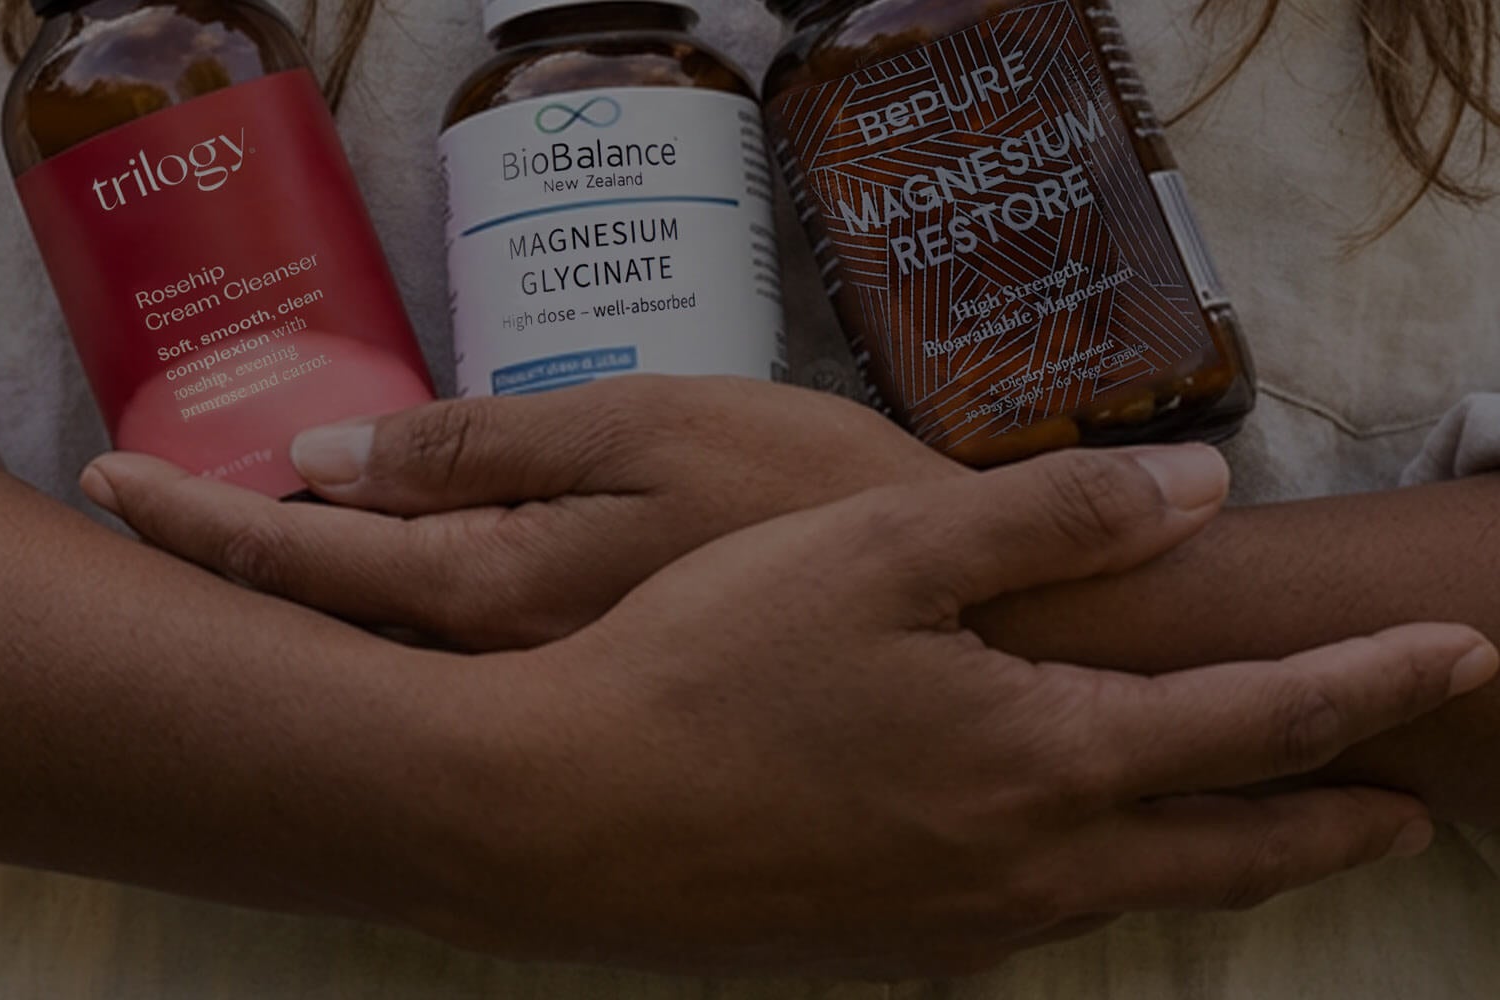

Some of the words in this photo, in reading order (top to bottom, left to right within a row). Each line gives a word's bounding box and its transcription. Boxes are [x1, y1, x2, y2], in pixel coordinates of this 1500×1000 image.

[92, 127, 244, 211] trilogy
[502, 139, 677, 181] BioBalance
[544, 177, 578, 192] New
[586, 172, 643, 189] Zealand
[837, 101, 1106, 237] MAGNESIUM
[509, 218, 679, 260] MAGNESIUM
[892, 162, 1094, 275] RESTORE
[135, 265, 225, 309] Rosehip
[145, 294, 221, 331] Cream
[223, 253, 318, 301] Cleanser
[522, 256, 673, 295] GLYCINATE
[952, 293, 1001, 321] High
[1003, 258, 1089, 302] Strength,
[157, 337, 199, 361] Soft,
[200, 308, 276, 347] smooth,
[277, 288, 325, 316] clean
[502, 308, 533, 331] High
[538, 304, 576, 324] dose
[593, 292, 697, 318] well-absorbed
[923, 312, 1033, 358] Bioavailable
[1035, 266, 1134, 319] Magnesium
[166, 334, 270, 381] complexion
[272, 315, 308, 338] with
[174, 371, 233, 401] rosehip,
[235, 343, 300, 377] evening
[989, 384, 999, 396] A
[1046, 339, 1115, 375] Supplement
[1005, 386, 1044, 412] Supply
[1100, 343, 1150, 370] Capsules
[180, 386, 248, 422] primrose
[250, 370, 280, 395] and
[282, 354, 333, 382] carrot.
